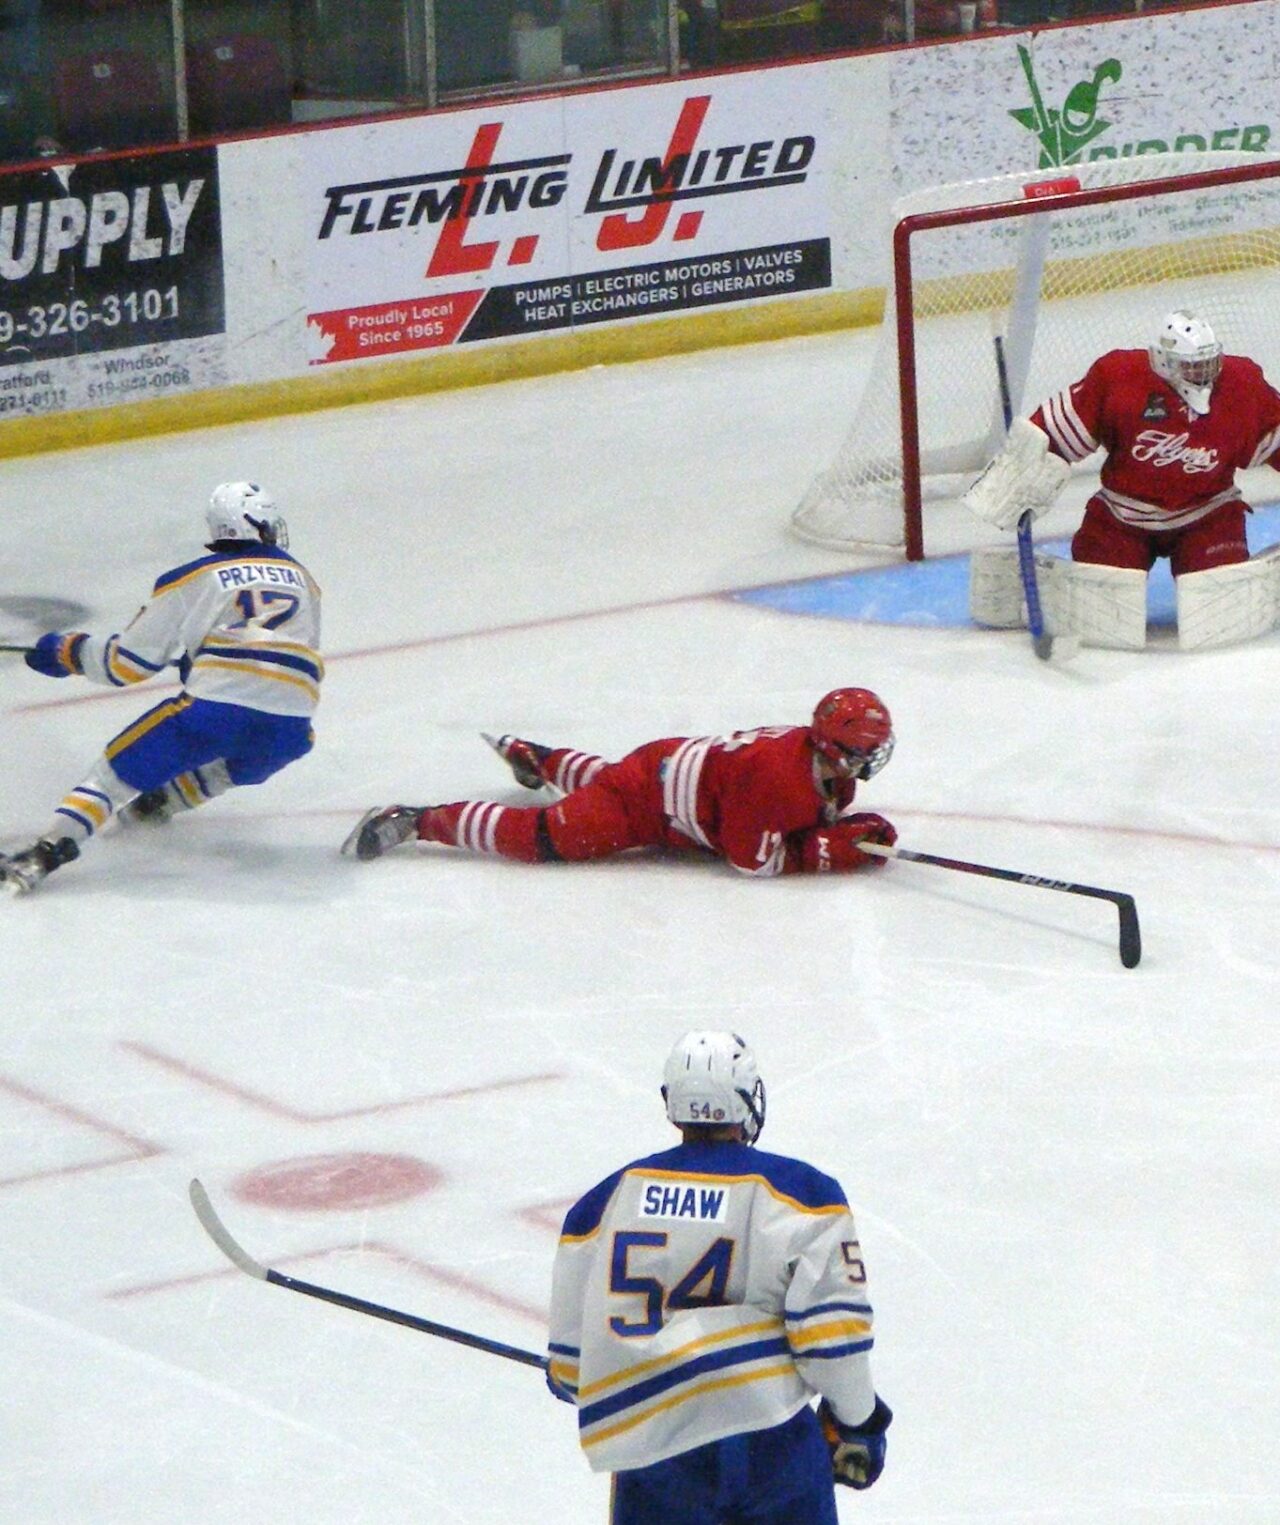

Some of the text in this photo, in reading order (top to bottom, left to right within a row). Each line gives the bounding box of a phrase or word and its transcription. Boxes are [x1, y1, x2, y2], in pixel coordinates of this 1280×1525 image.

[318, 135, 815, 239] FLEMING LIMITED
[515, 249, 803, 305] PUMPS ELECTRIC MOTORS VALVES
[524, 268, 795, 322] HEAT EXCHANGERS GENERATORS
[349, 302, 453, 330] Proudly Local
[359, 321, 444, 347] Since 1965
[689, 1102, 711, 1119] 54
[643, 1185, 724, 1219] SHAW
[608, 1230, 736, 1338] 54
